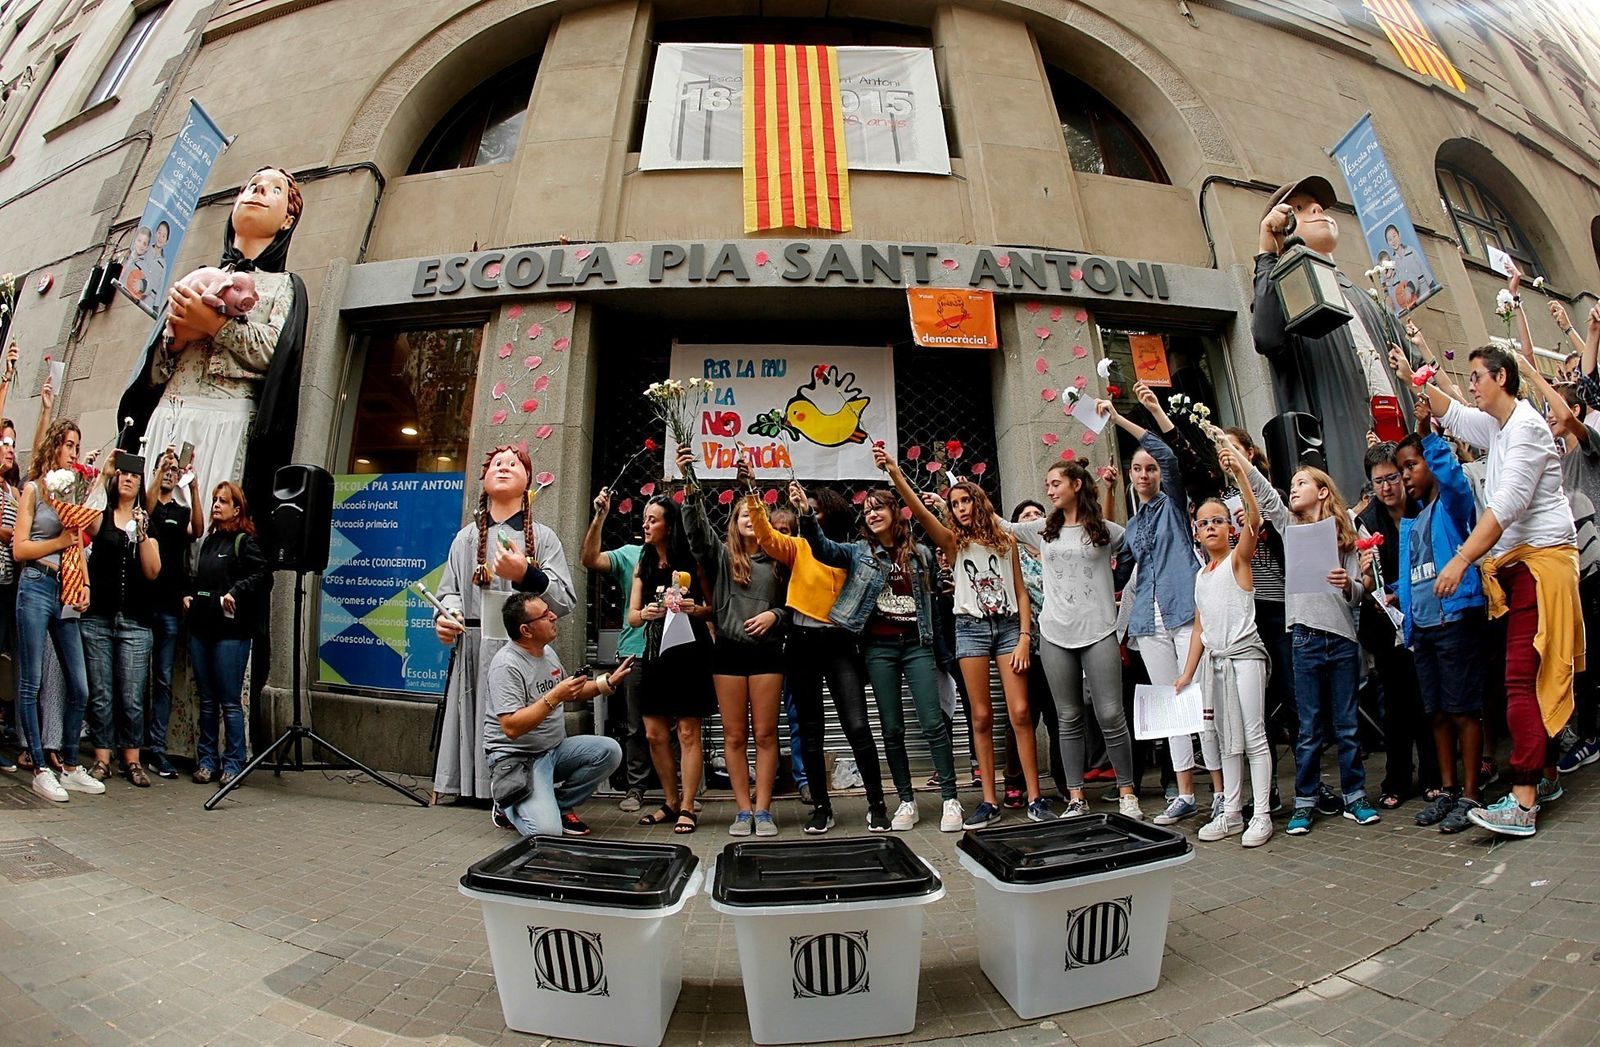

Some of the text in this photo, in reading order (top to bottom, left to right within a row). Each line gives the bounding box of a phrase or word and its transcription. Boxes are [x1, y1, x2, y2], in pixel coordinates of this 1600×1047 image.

[860, 76, 900, 87] Antoni
[183, 132, 212, 167] Escola Pia
[1348, 151, 1368, 172] Escola
[1366, 141, 1378, 153] Pia
[171, 151, 203, 185] 4 de març
[1358, 176, 1367, 187] de
[1367, 160, 1385, 179] març
[173, 169, 184, 181] de
[183, 177, 199, 194] 2017
[1363, 186, 1373, 196] de
[1372, 169, 1388, 188] 2017
[411, 243, 1169, 300] ESCOLA PIA SANT ANTONI
[921, 333, 987, 345] democràcia!
[703, 358, 787, 379] PER LA PAU
[715, 388, 736, 406] LA
[702, 411, 742, 437] NO
[335, 480, 464, 492] ESCOLA PIA SANT ANTONI
[367, 500, 399, 511] infantil
[331, 519, 399, 530] Educació primària
[371, 558, 427, 570] (CONCERTAT)
[325, 576, 344, 585] CFGS
[357, 576, 394, 587] Educació
[324, 596, 364, 606] Programes
[366, 597, 377, 605] de
[378, 598, 416, 608] Formació
[322, 633, 410, 647] Extraescolar al Casal
[407, 667, 449, 680] Escola Pi
[406, 679, 440, 689] Sant Antoni
[536, 679, 554, 694] fato
